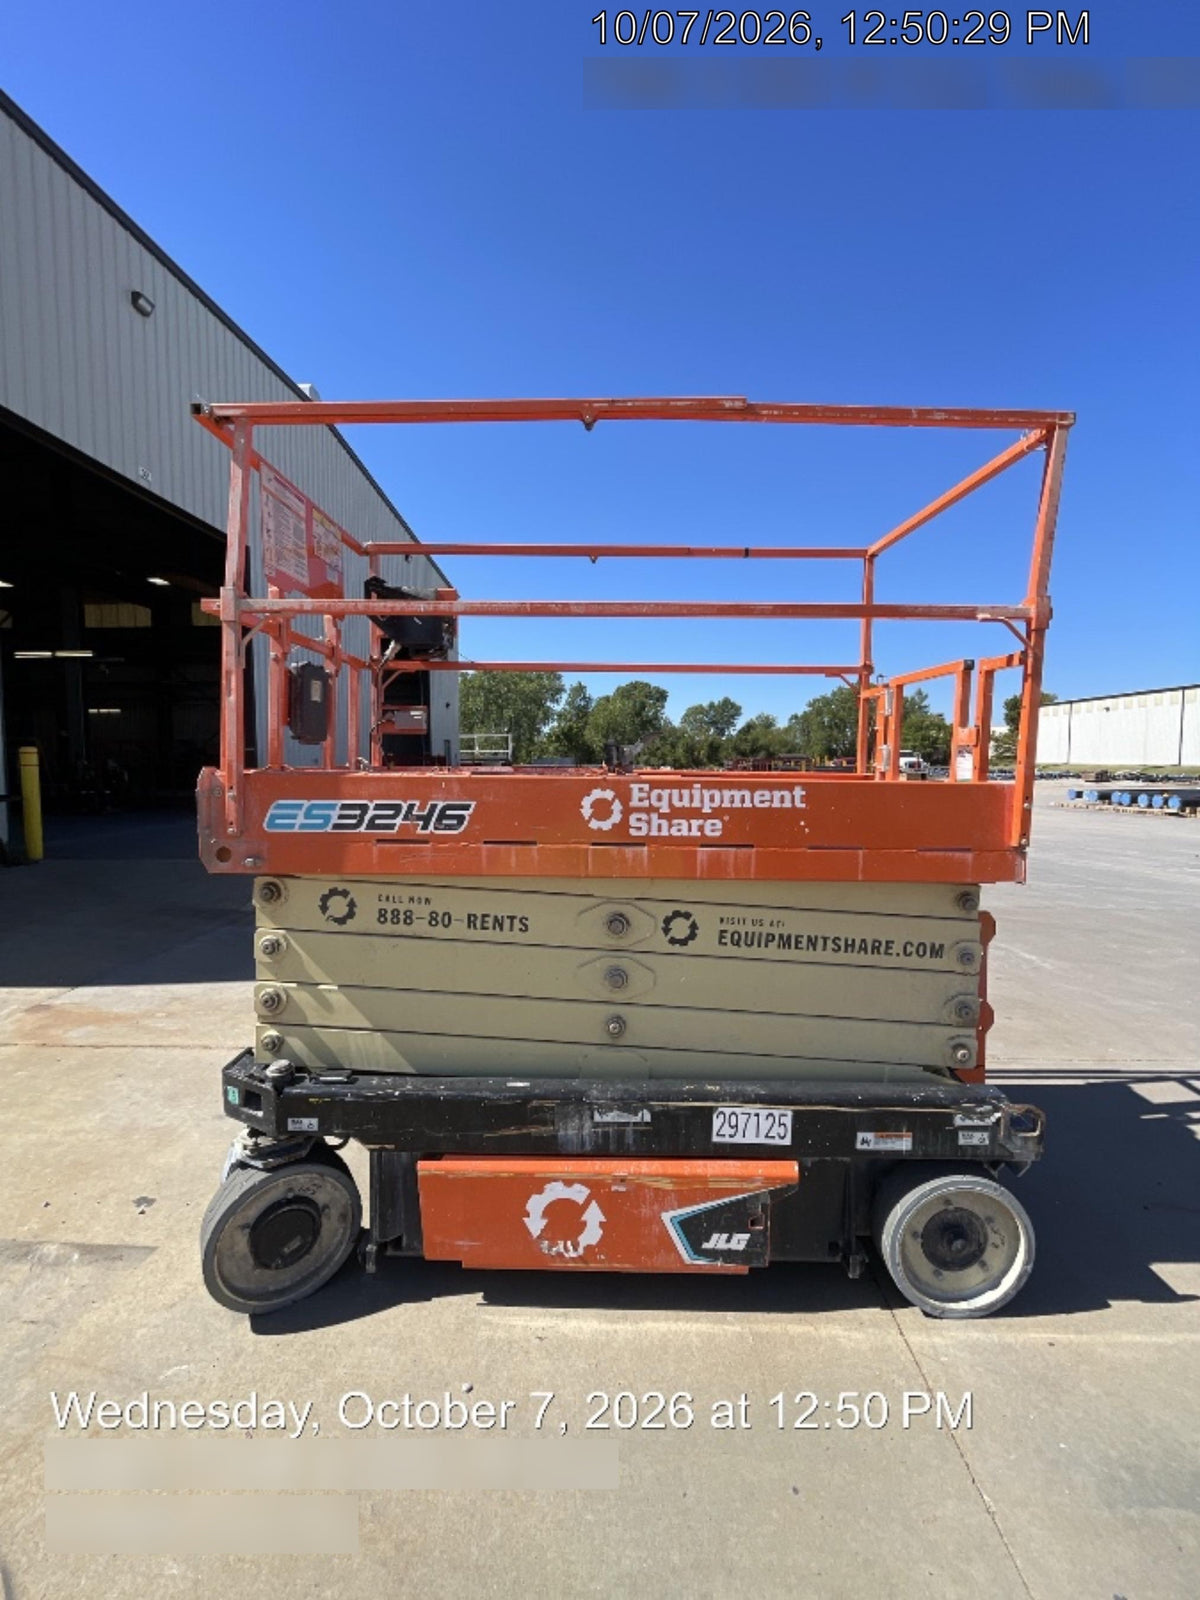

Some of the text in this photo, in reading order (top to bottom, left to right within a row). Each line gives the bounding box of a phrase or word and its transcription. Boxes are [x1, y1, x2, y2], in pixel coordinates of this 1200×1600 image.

[629, 783, 807, 813] Equipment
[263, 799, 476, 834] ES3246
[377, 908, 529, 933] 888-80-RENTS
[751, 918, 764, 927] US
[718, 929, 945, 960] EQUIPMENTSHARE.COM
[715, 1110, 789, 1141] 297125
[702, 1233, 751, 1251] JLG
